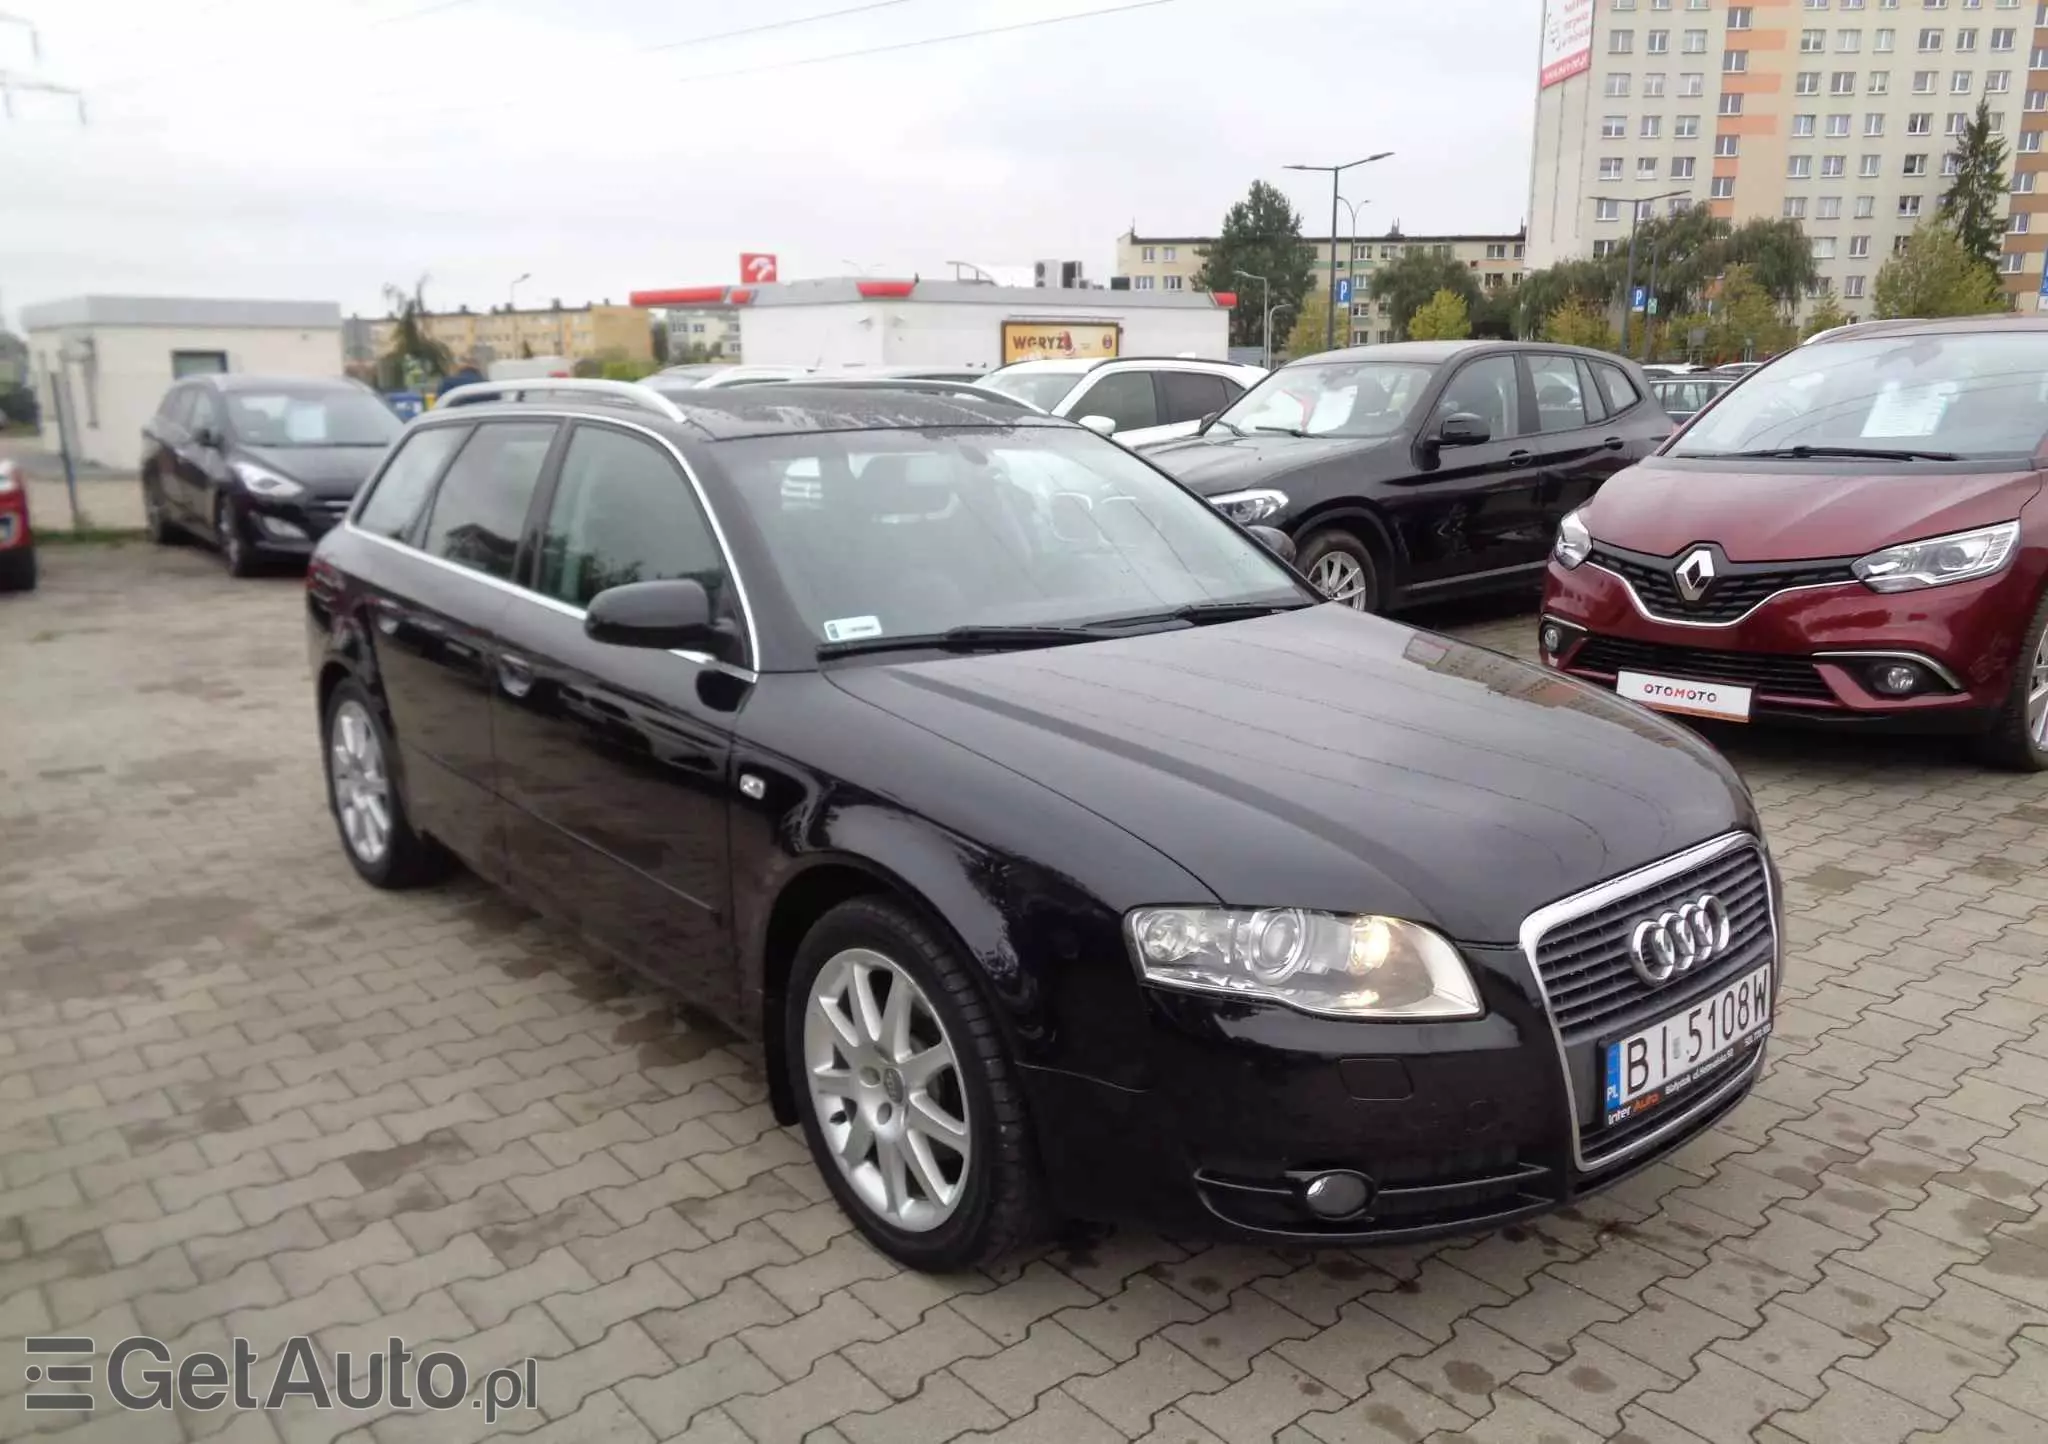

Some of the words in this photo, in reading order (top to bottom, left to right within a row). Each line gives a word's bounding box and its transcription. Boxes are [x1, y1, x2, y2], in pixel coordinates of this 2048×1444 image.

[1340, 280, 1348, 301] P
[1635, 289, 1643, 306] P
[1643, 683, 1718, 703] OTOMOTO
[1627, 1025, 1668, 1095] BI
[1687, 967, 1768, 1063] 5108W
[1606, 1084, 1619, 1102] PL
